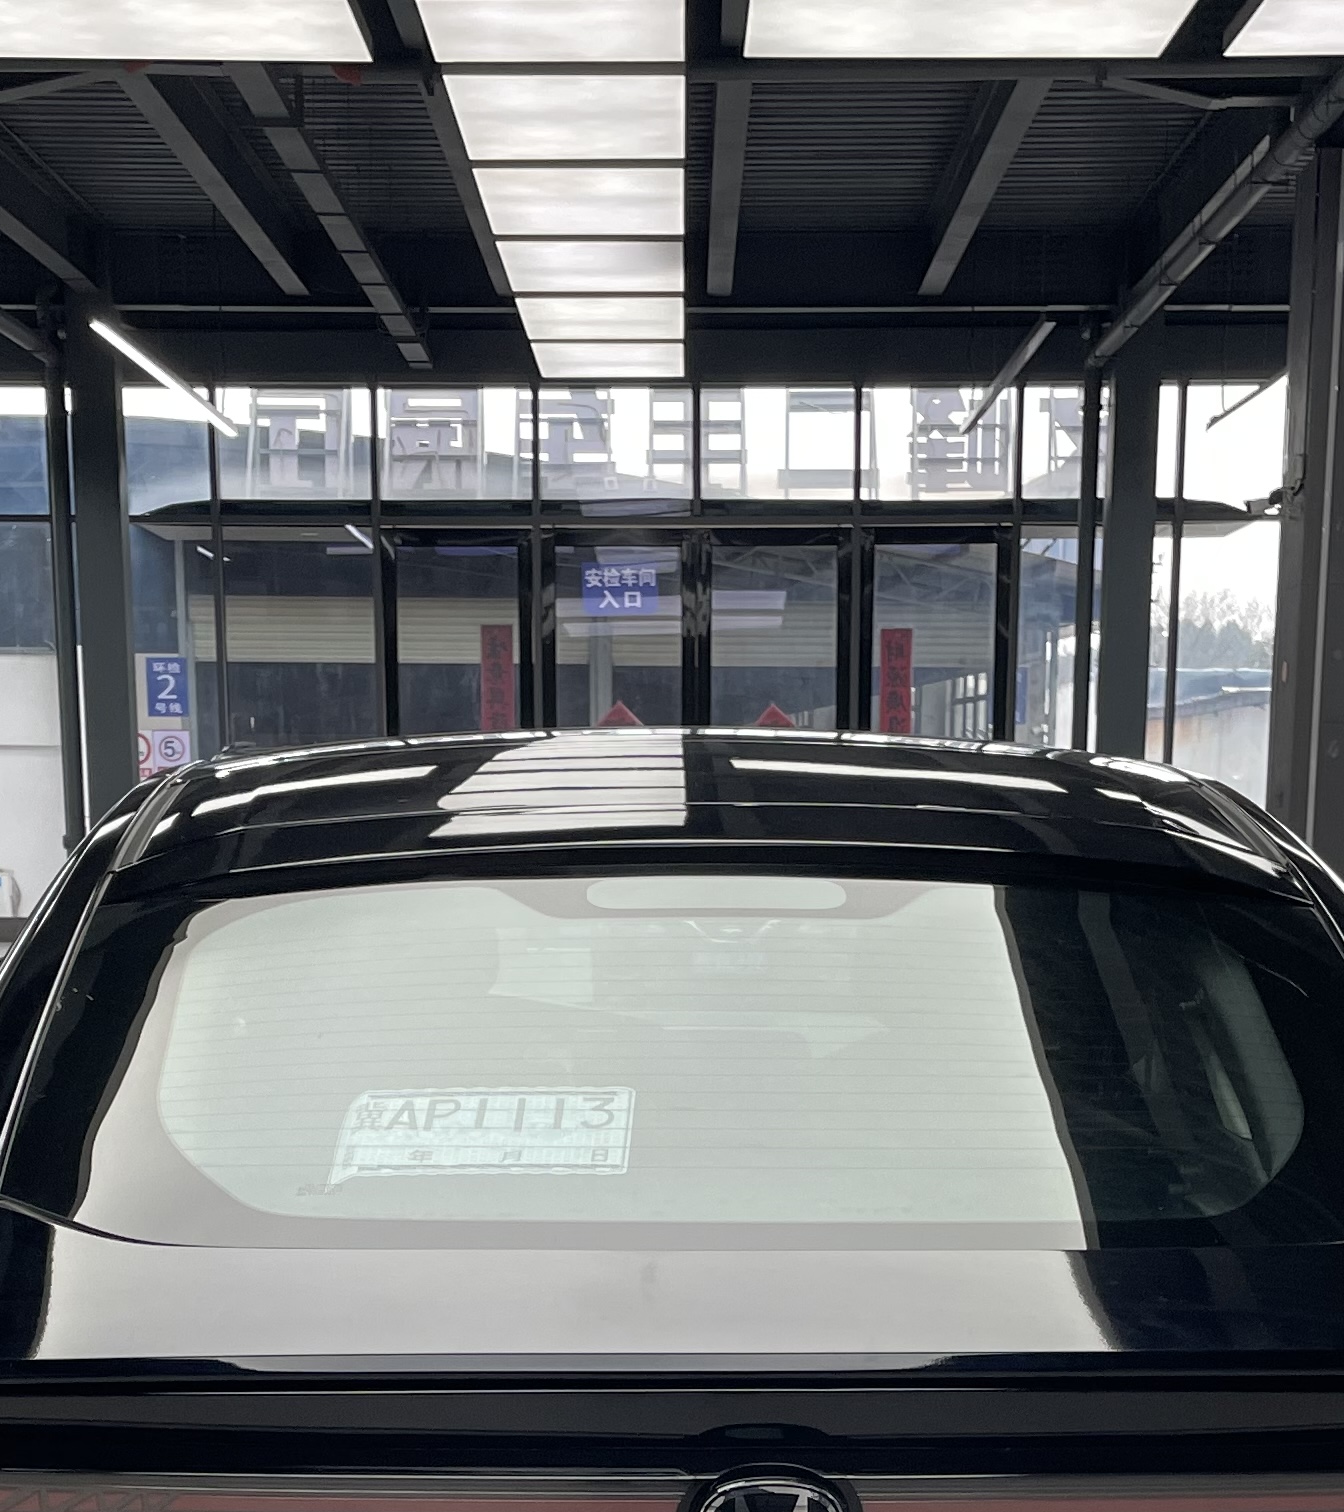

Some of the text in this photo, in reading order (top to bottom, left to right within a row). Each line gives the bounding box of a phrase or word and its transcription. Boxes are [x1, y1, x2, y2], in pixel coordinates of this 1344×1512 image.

[584, 567, 657, 588] 安检车间
[598, 590, 643, 609] 入口
[152, 661, 181, 674] 环检
[156, 674, 178, 700] 2
[154, 702, 184, 714] 号线
[353, 1096, 616, 1134] 冀AP1113
[407, 1149, 610, 1163] 年 月 日
